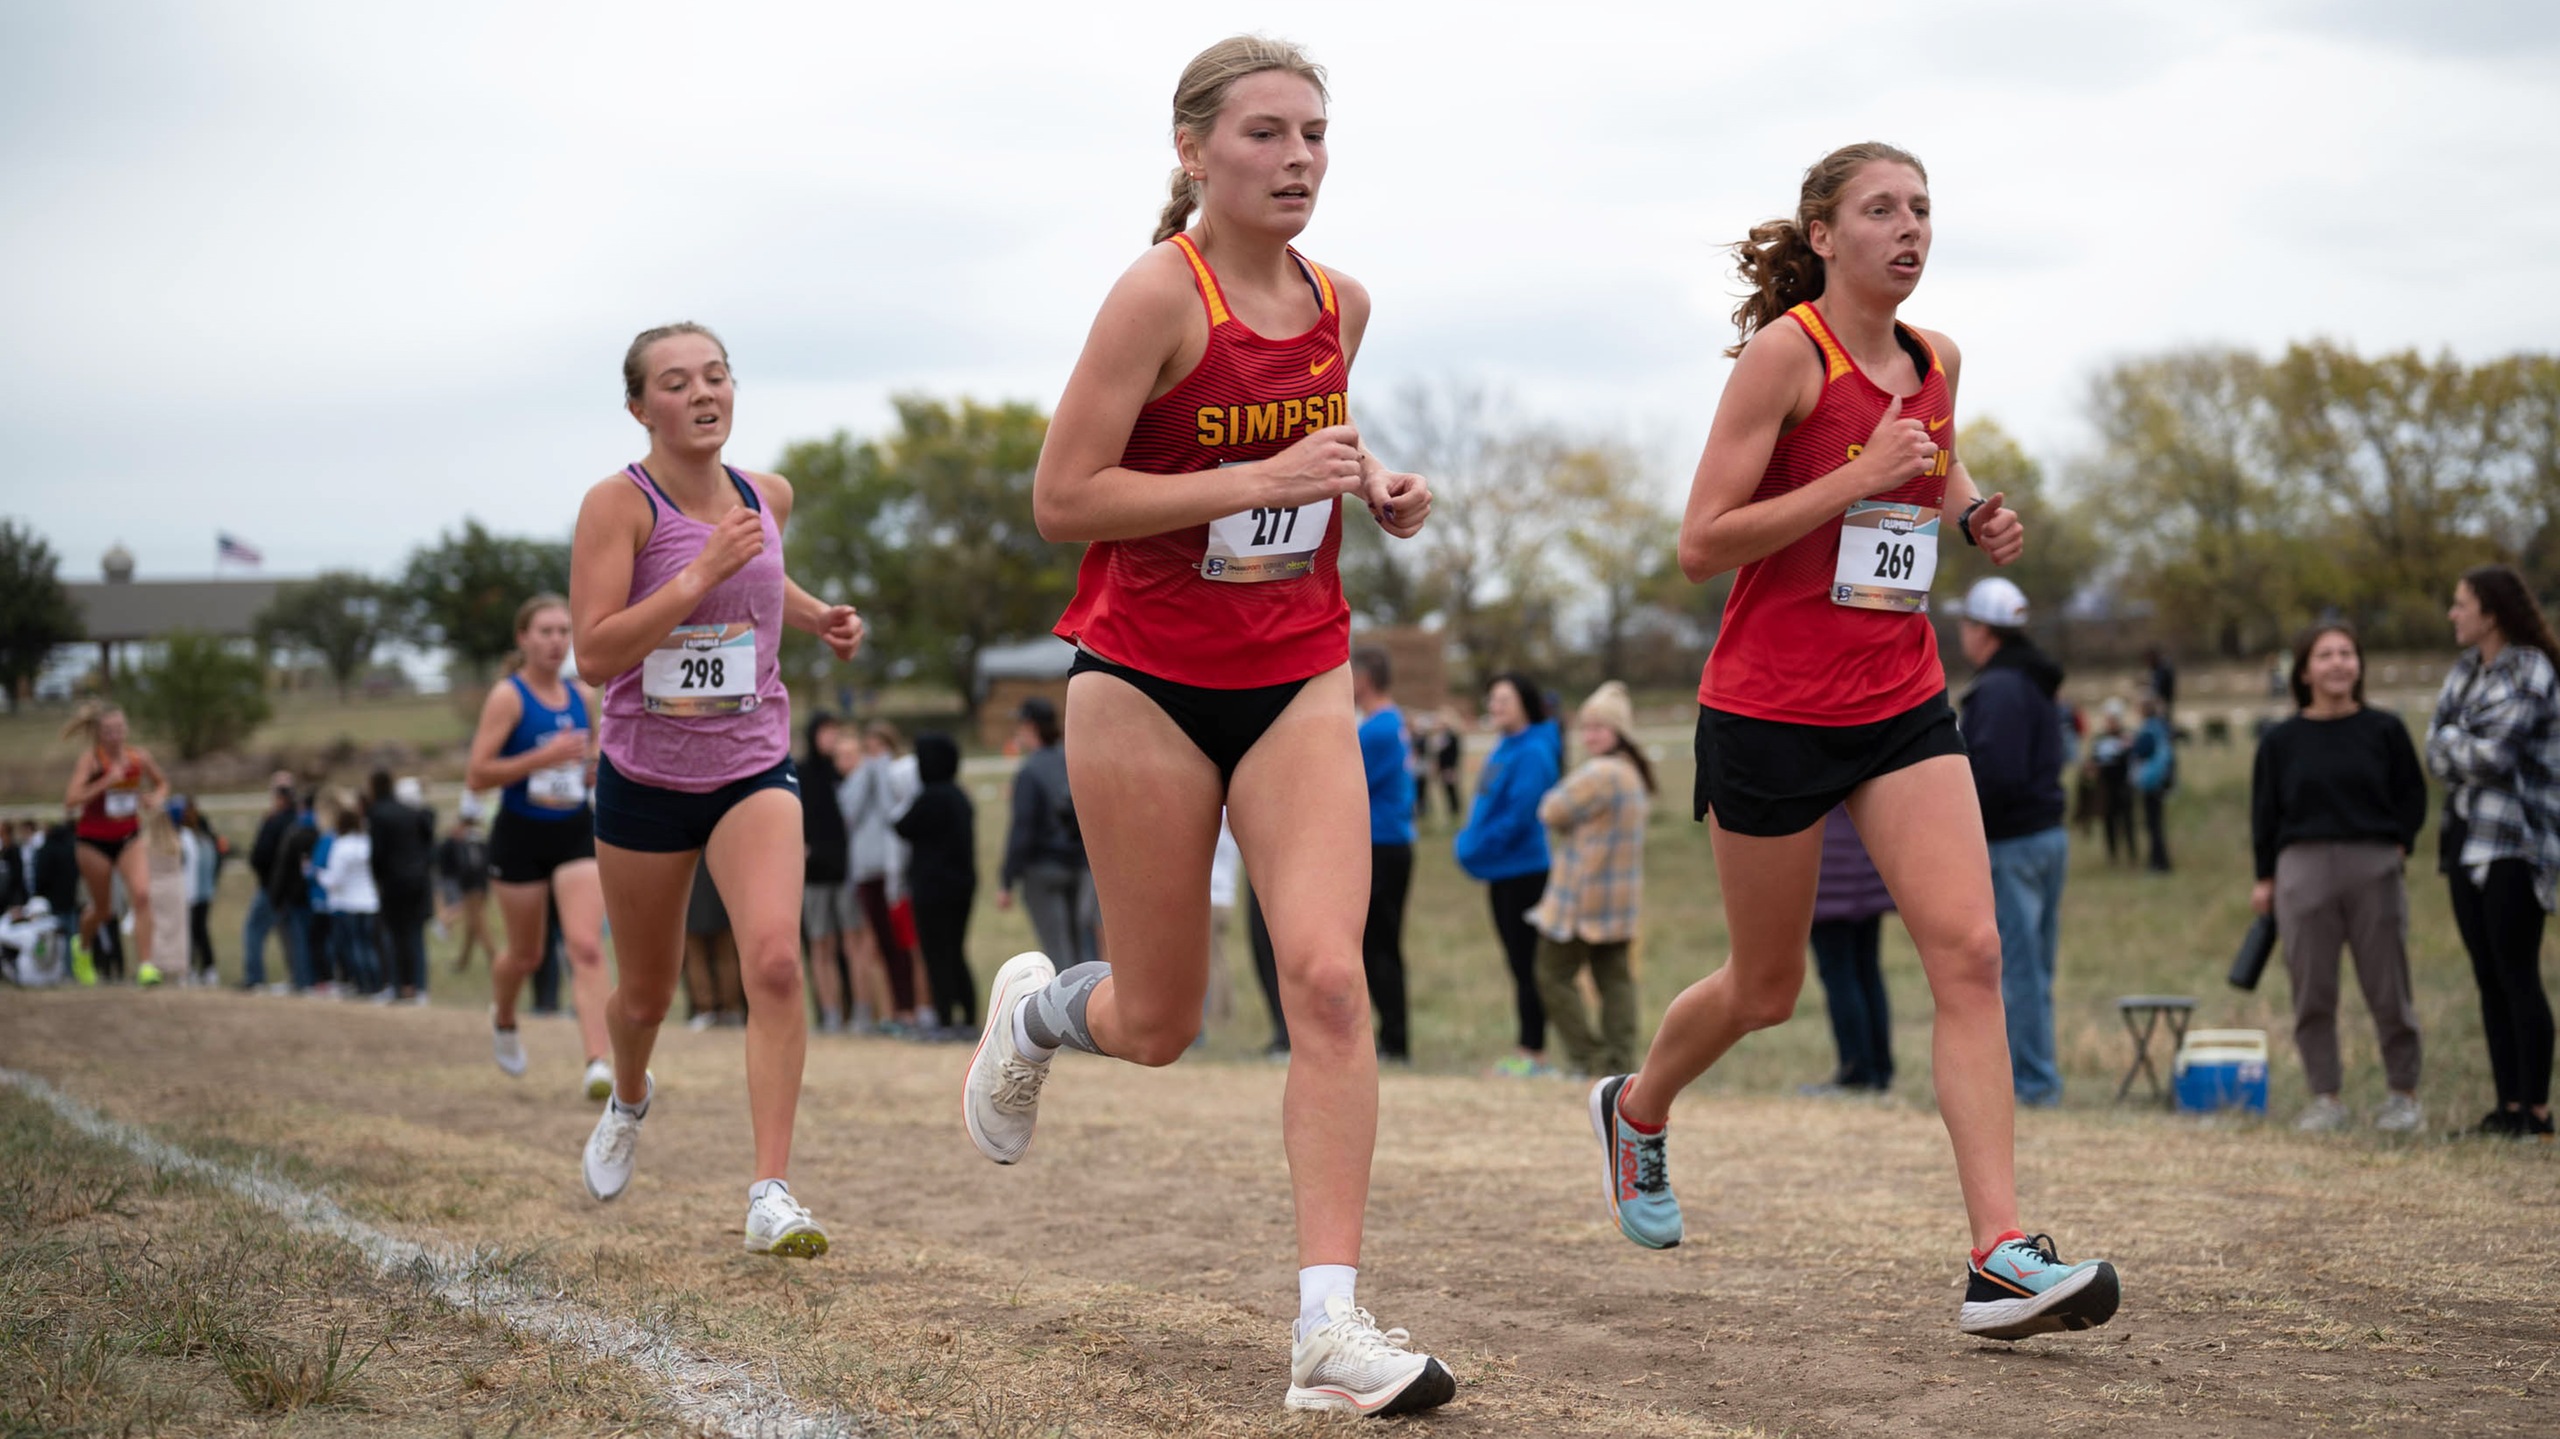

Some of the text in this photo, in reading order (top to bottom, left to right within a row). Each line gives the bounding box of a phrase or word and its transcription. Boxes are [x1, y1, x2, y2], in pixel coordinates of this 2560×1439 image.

[1251, 507, 1300, 546] 277
[1874, 541, 1915, 580] 269
[680, 657, 724, 689] 298
[1620, 1138, 1638, 1201] HOKA
